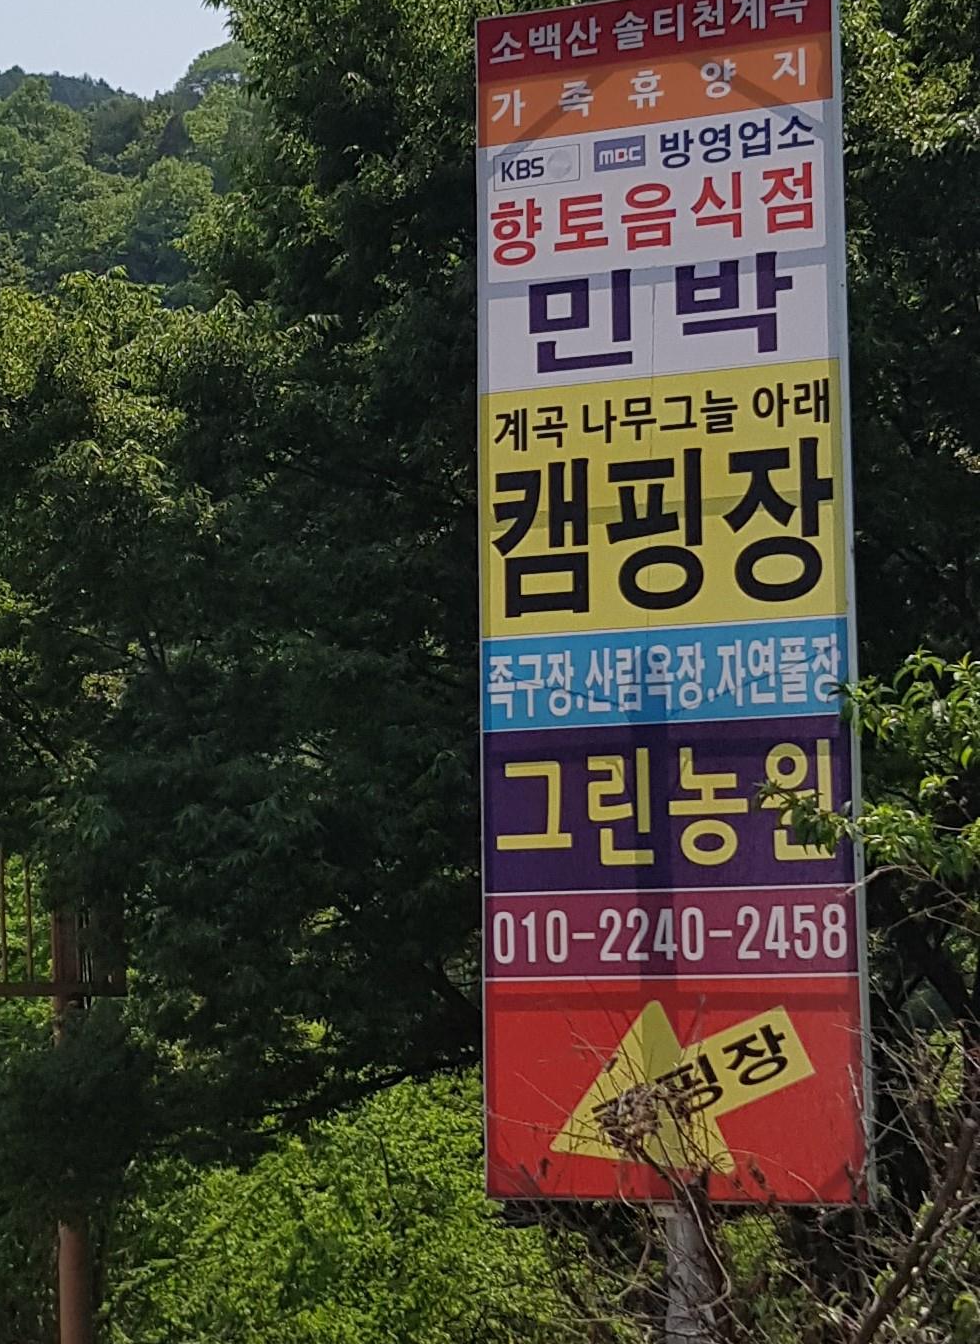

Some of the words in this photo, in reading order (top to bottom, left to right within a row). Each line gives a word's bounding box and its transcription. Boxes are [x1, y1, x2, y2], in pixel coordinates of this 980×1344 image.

[489, 18, 601, 64] 소백산
[501, 157, 545, 183] KBS
[659, 115, 815, 169] 방영업소
[490, 161, 814, 267] 향토음식점
[528, 251, 793, 374] 민박
[494, 405, 568, 452] 계곡
[582, 390, 738, 444] 나무그늘
[752, 378, 831, 427] 아래
[491, 437, 834, 618] 캠핑장
[496, 739, 837, 866] 그린농원
[493, 903, 848, 965] 010-2240-2458
[591, 1023, 789, 1148] 핑장
